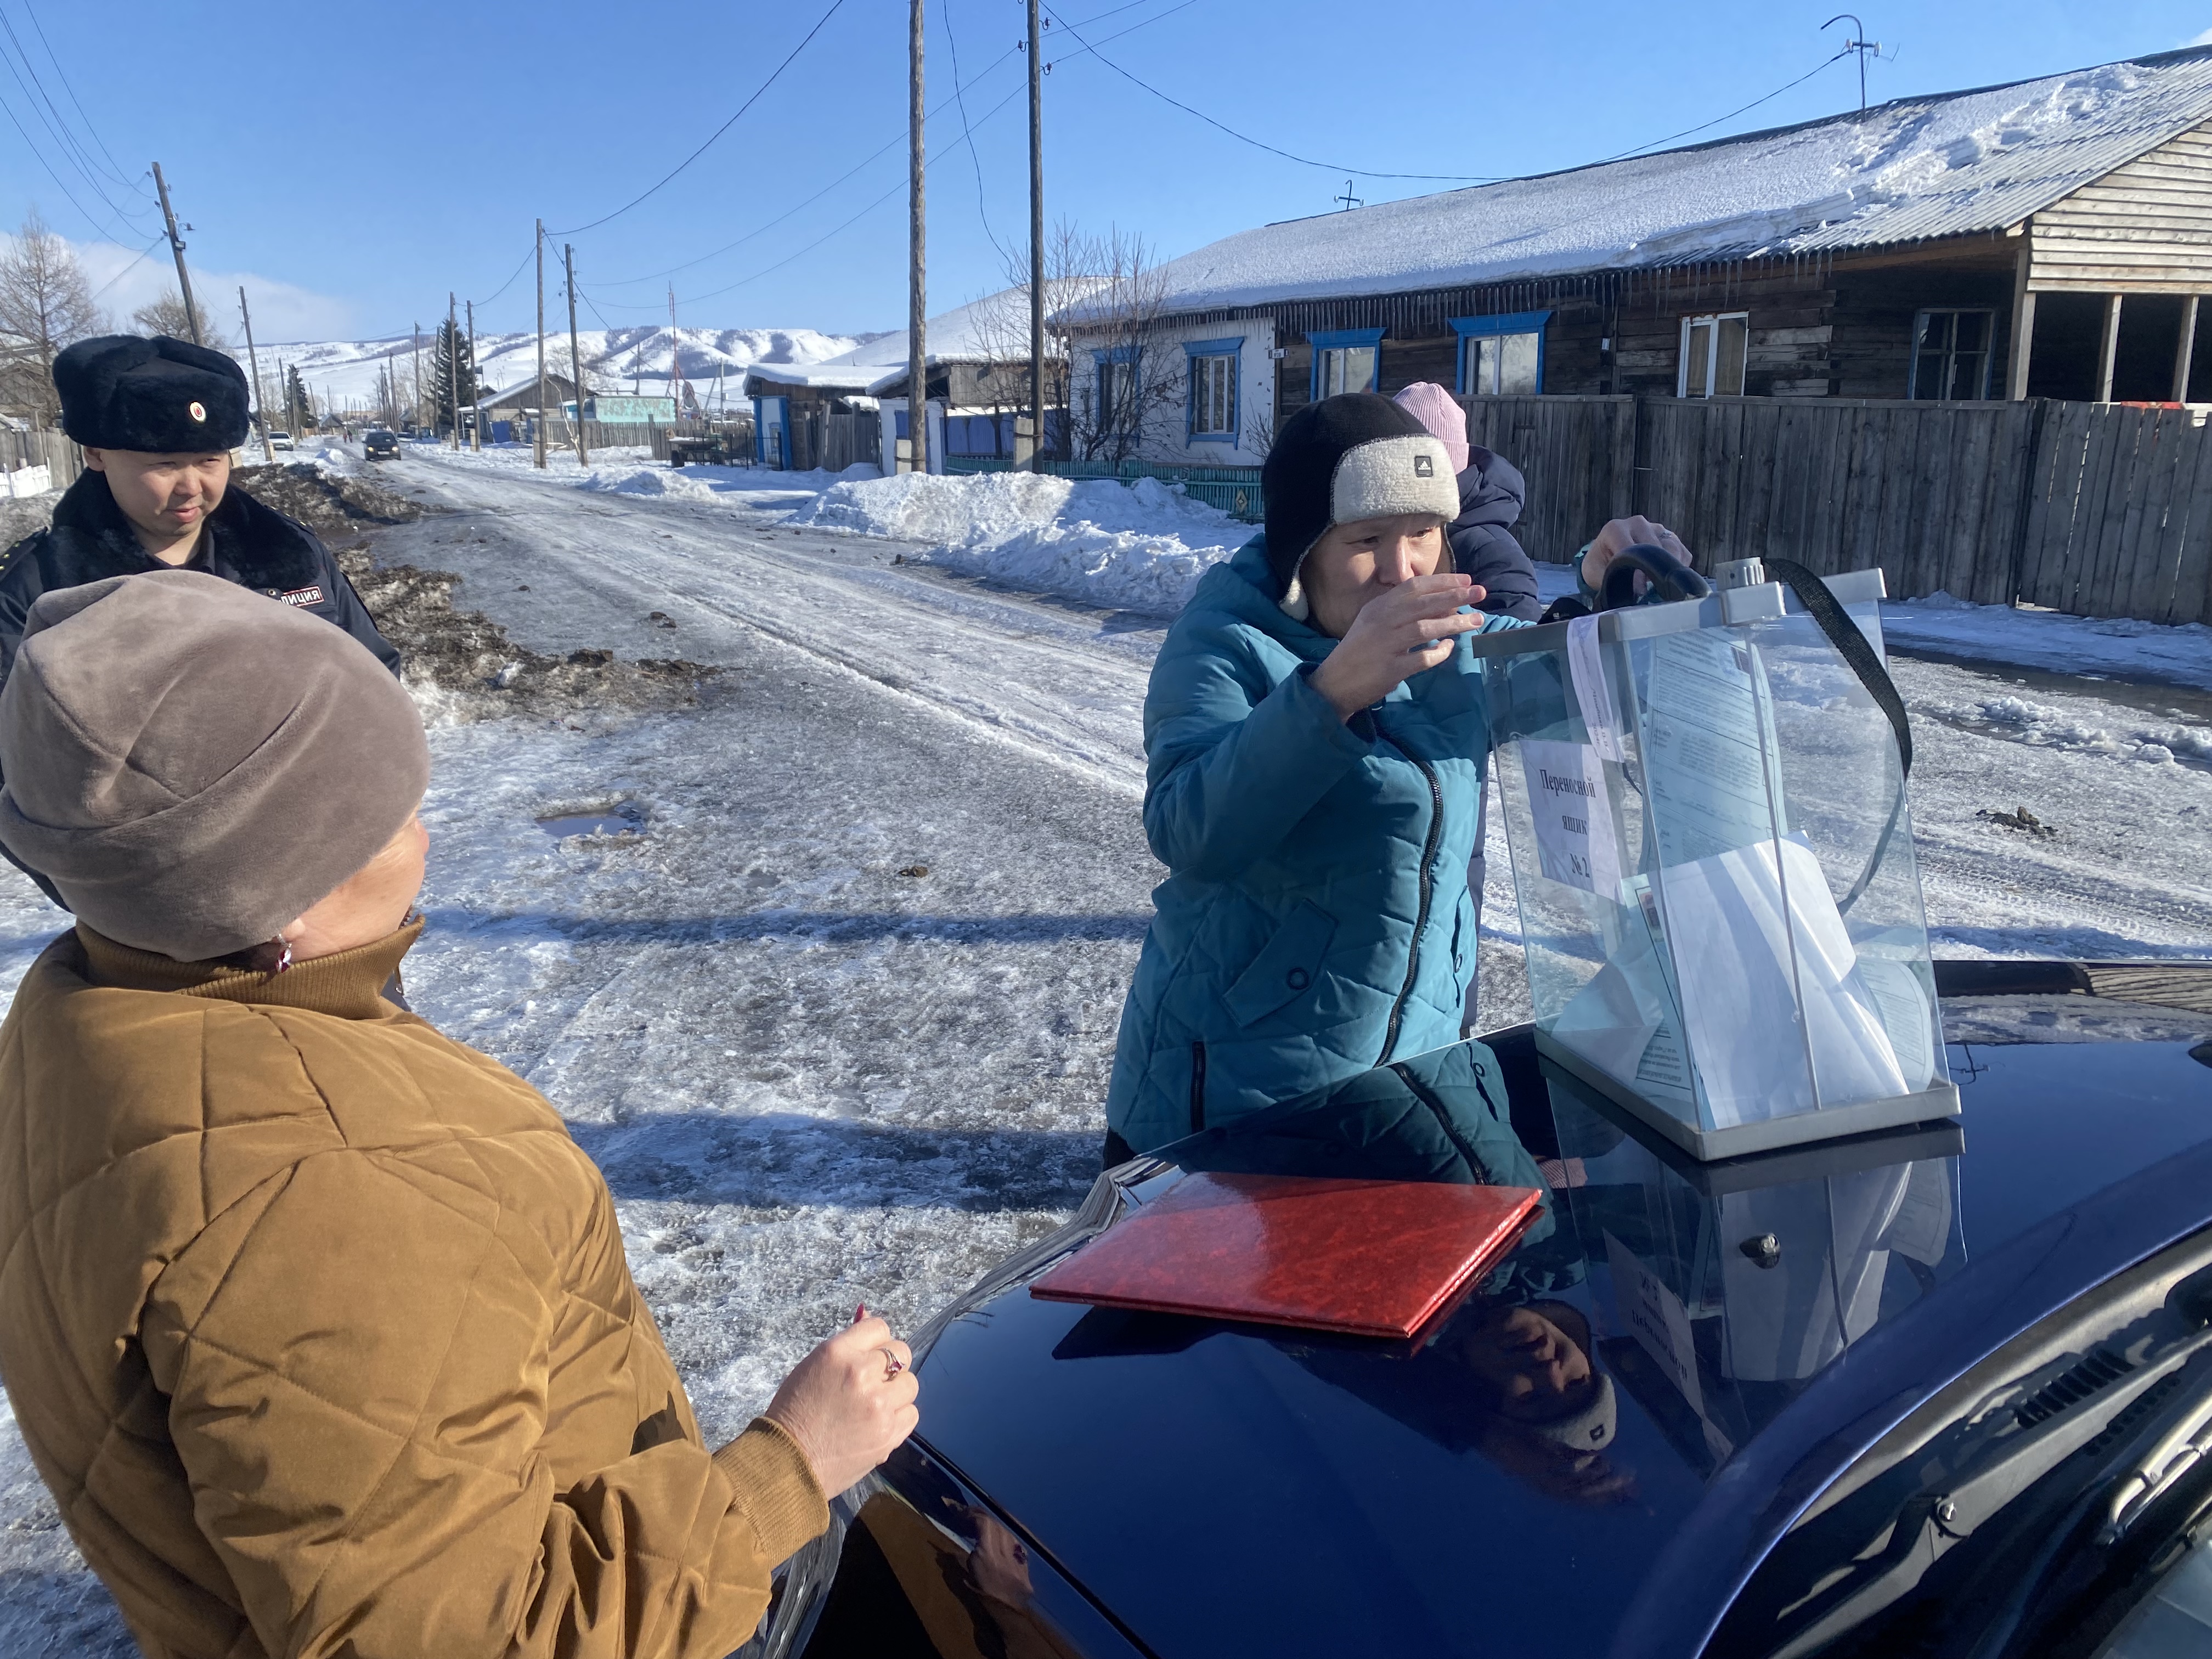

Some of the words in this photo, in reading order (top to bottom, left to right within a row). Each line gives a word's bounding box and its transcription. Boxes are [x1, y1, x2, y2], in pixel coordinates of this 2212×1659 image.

[279, 590, 320, 605] ЛИЦИЯ
[1539, 769, 1596, 798] Переносной
[1562, 815, 1588, 835] ящик
